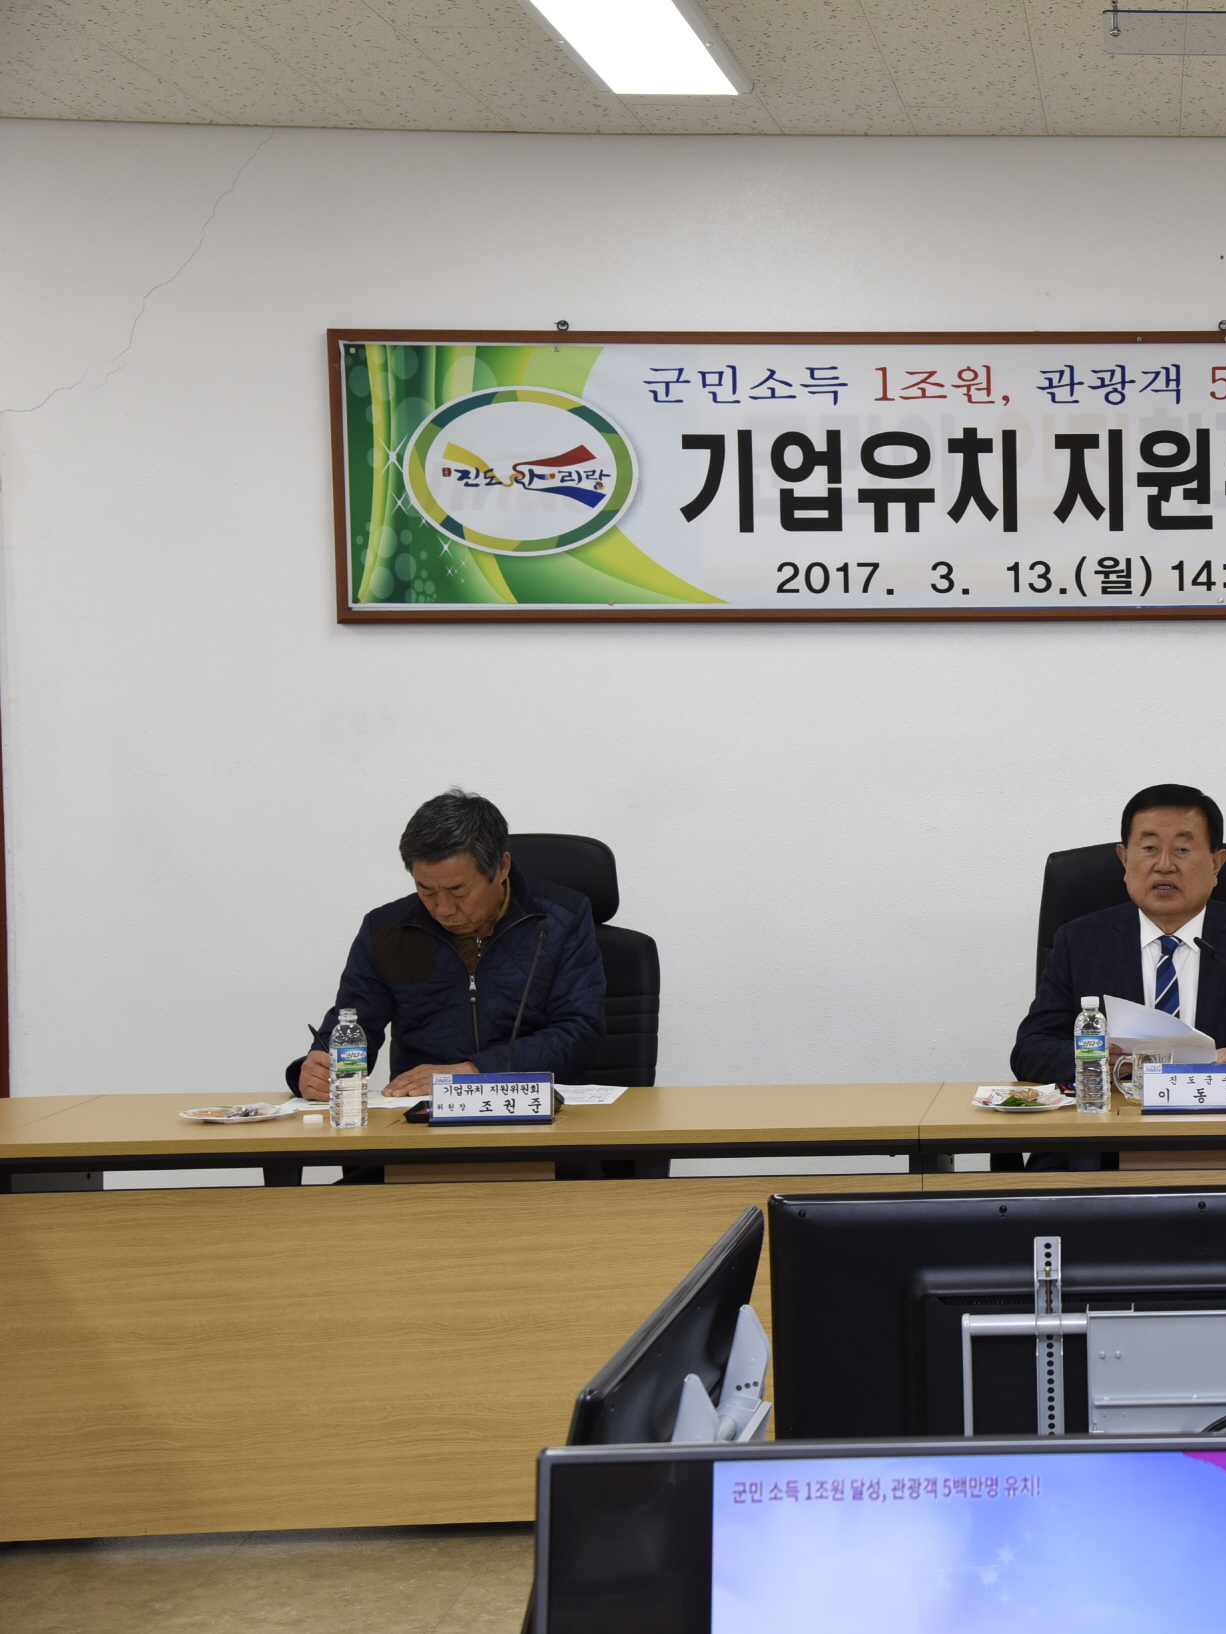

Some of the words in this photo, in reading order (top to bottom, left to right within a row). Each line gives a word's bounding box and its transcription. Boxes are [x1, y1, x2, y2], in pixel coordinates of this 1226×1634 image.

[643, 365, 848, 405] 군민소득
[875, 365, 1009, 406] 1조원,
[1037, 364, 1180, 405] 관광객
[680, 428, 1017, 532] 기업유치
[777, 562, 894, 595] 2017.
[931, 561, 969, 595] 3.
[1007, 556, 1152, 597] 13.(월)
[436, 1102, 467, 1112] 위원장
[478, 1097, 542, 1114] 조권준
[443, 1084, 484, 1097] 기업유치
[490, 1083, 540, 1096] 지원위원회
[732, 1481, 763, 1504] 군민
[768, 1480, 800, 1502] 소득
[805, 1479, 845, 1501] 1조원
[850, 1478, 887, 1503] 달성,
[891, 1477, 938, 1500] 관광객
[943, 1476, 999, 1499] 5백만명
[1003, 1475, 1040, 1498] 유치!
